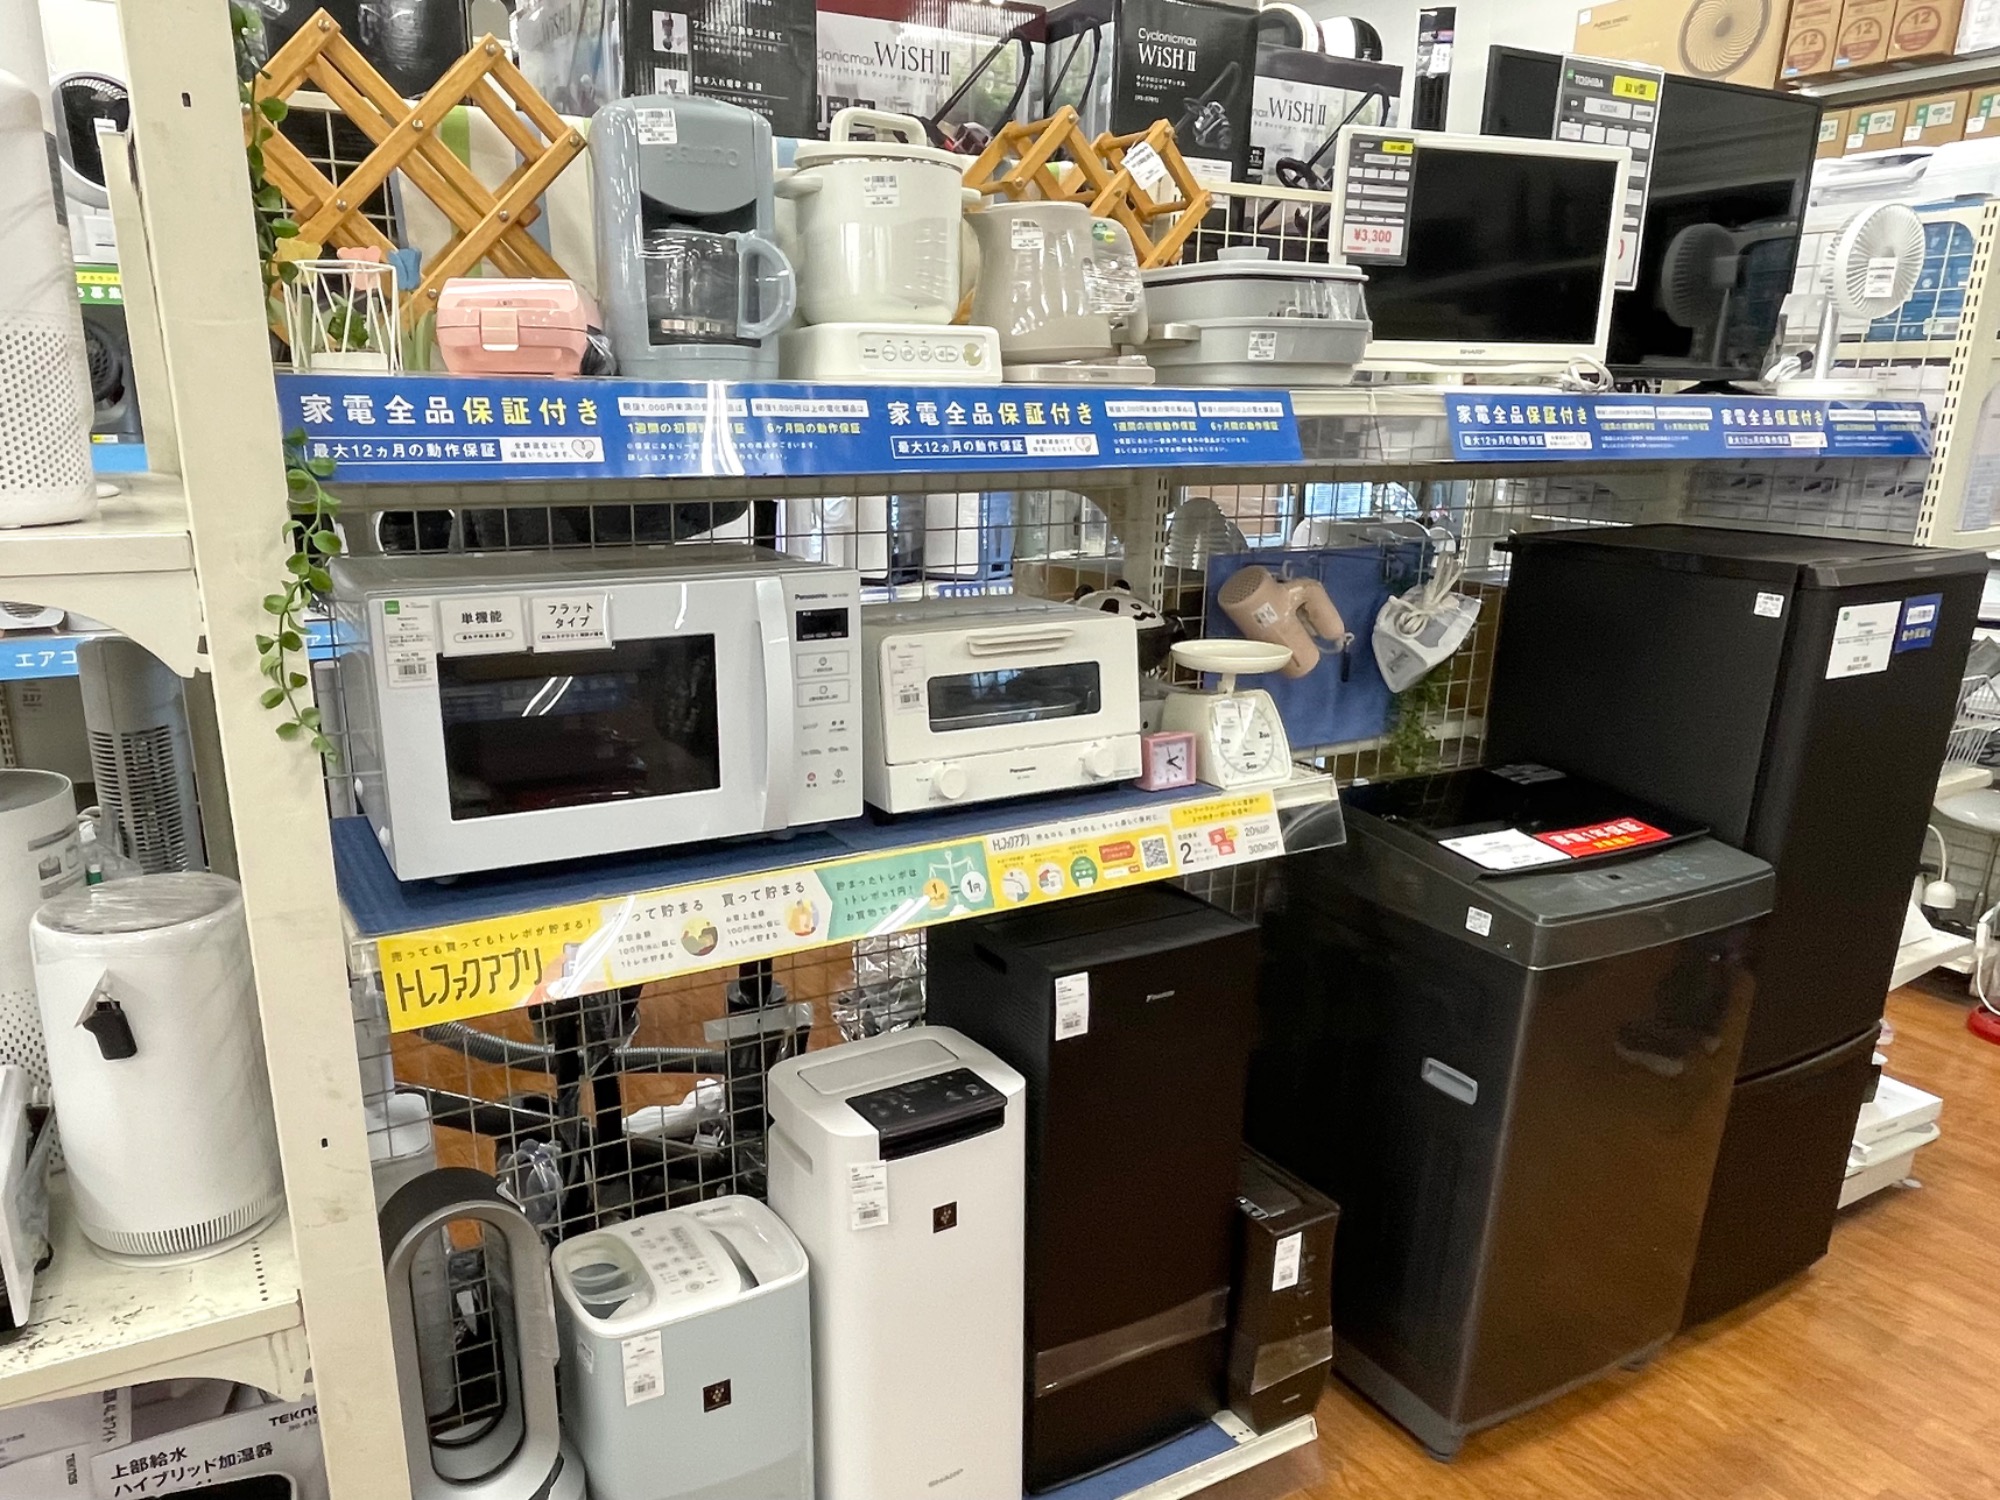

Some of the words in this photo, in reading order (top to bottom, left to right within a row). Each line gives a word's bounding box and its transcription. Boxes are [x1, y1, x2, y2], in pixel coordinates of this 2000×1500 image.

[1138, 27, 1197, 47] Cyclonicmax
[874, 41, 934, 73] WiSH
[1138, 43, 1184, 71] WiSH
[1269, 97, 1313, 124] WiSH
[1354, 228, 1392, 244] ¥3,300
[300, 394, 598, 426] 家電全品保証付き
[887, 401, 1092, 426] 家電全品保証付き
[1457, 404, 1587, 425] 家電全品保証付き
[461, 610, 502, 624] 単機能
[547, 602, 593, 615] フラット
[555, 616, 590, 629] タイプ
[1181, 842, 1194, 865] 2
[722, 882, 805, 907] 買って貯まる
[618, 899, 704, 922] って貯まる
[395, 947, 542, 1012] トレファクアプリ
[111, 1446, 187, 1480] 上部給水
[114, 1441, 273, 1498] ハイブリッド加湿器
